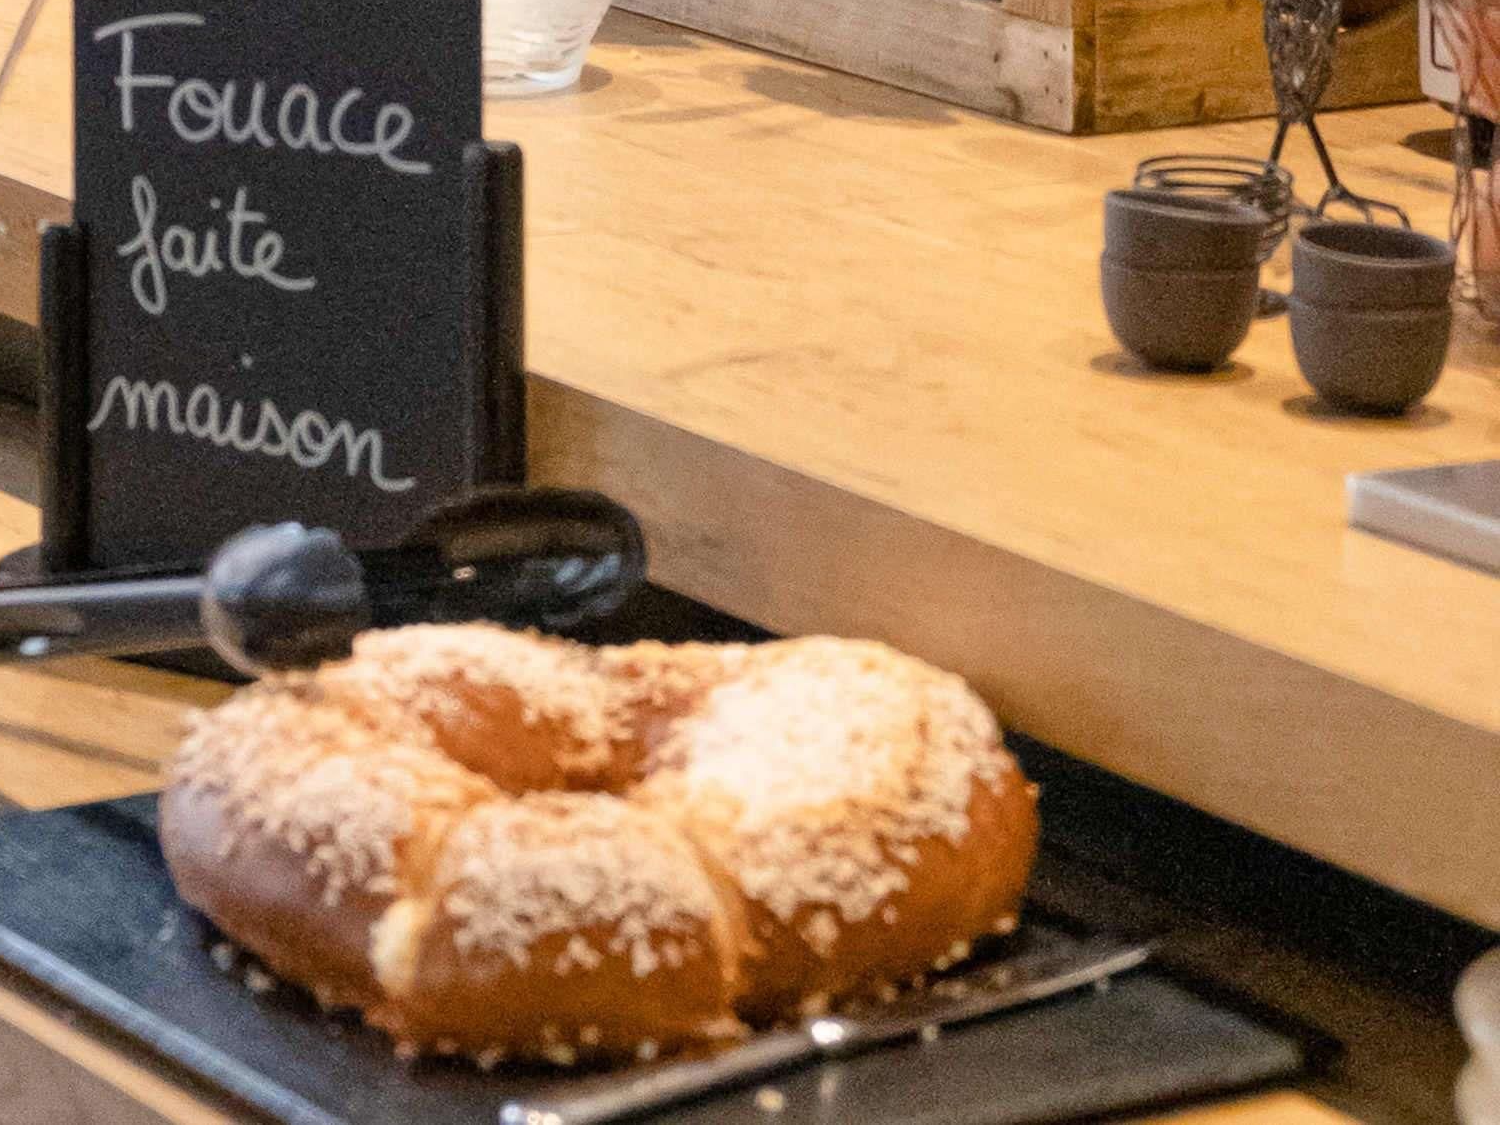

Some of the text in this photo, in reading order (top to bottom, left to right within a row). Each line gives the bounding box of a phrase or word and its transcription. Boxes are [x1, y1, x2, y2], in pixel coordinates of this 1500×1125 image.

[94, 12, 432, 174] Fouace
[118, 176, 315, 314] faite
[87, 355, 416, 491] maison
